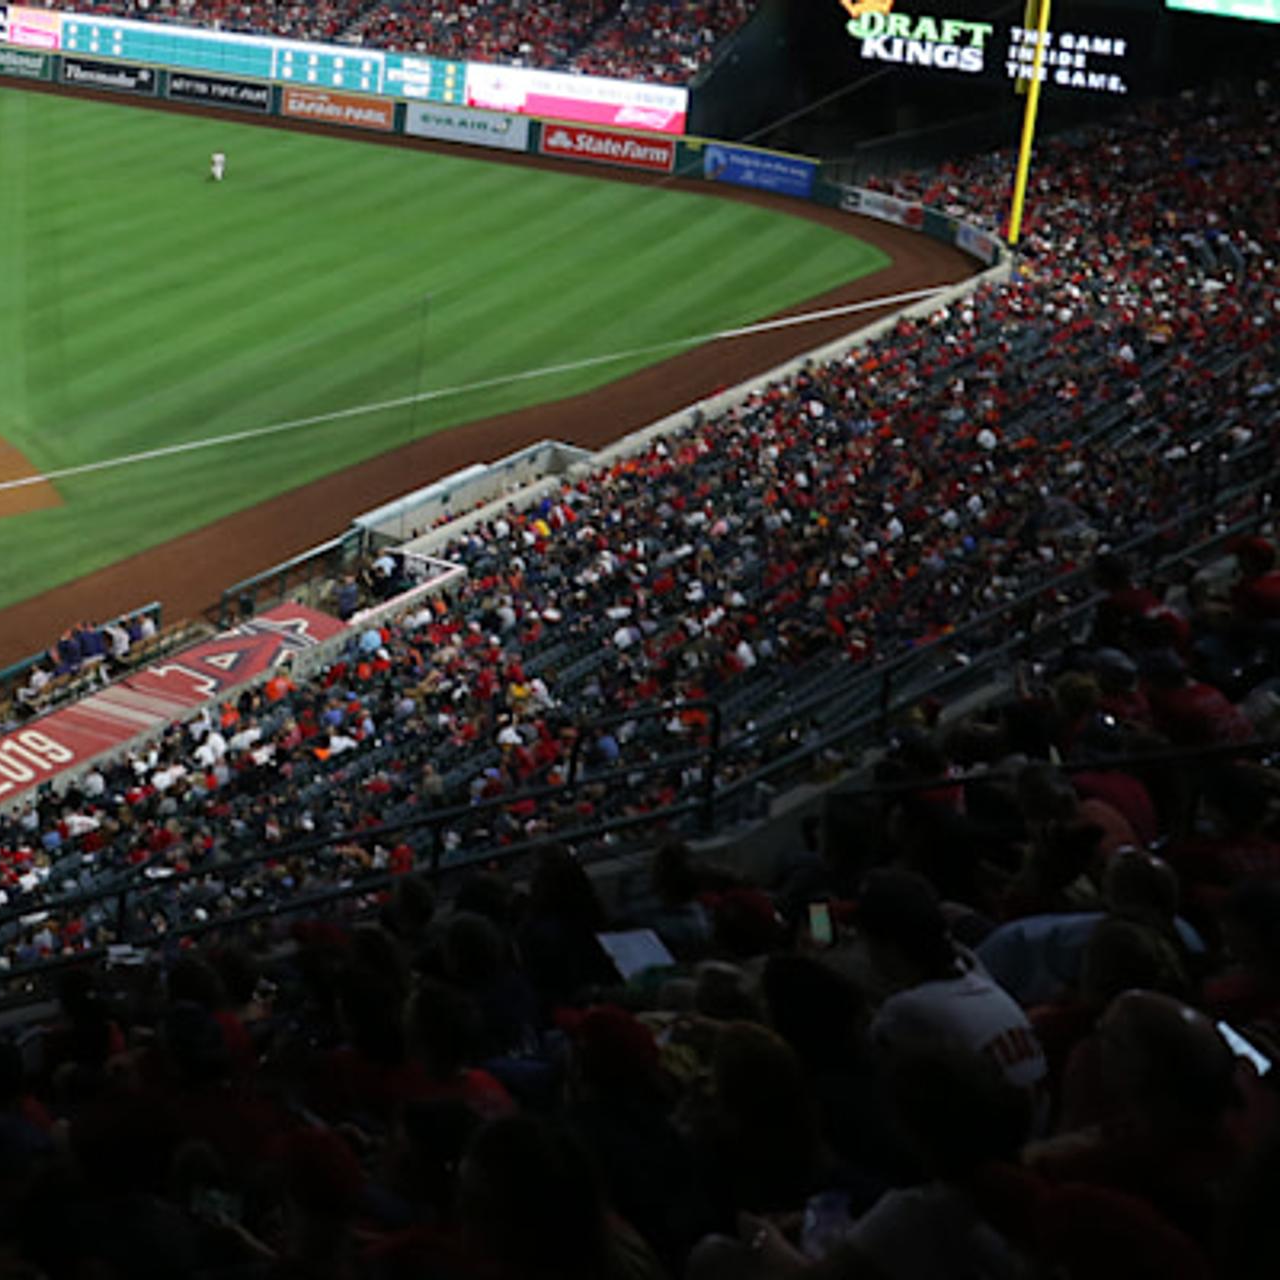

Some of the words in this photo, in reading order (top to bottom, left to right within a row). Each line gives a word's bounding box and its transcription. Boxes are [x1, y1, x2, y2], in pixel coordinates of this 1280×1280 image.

[846, 11, 993, 49] DRAFT
[1010, 26, 1053, 47] THE
[1059, 33, 1127, 56] GAME
[860, 35, 985, 73] KINGS
[1005, 60, 1048, 82] THE
[1054, 68, 1127, 94] GAME.
